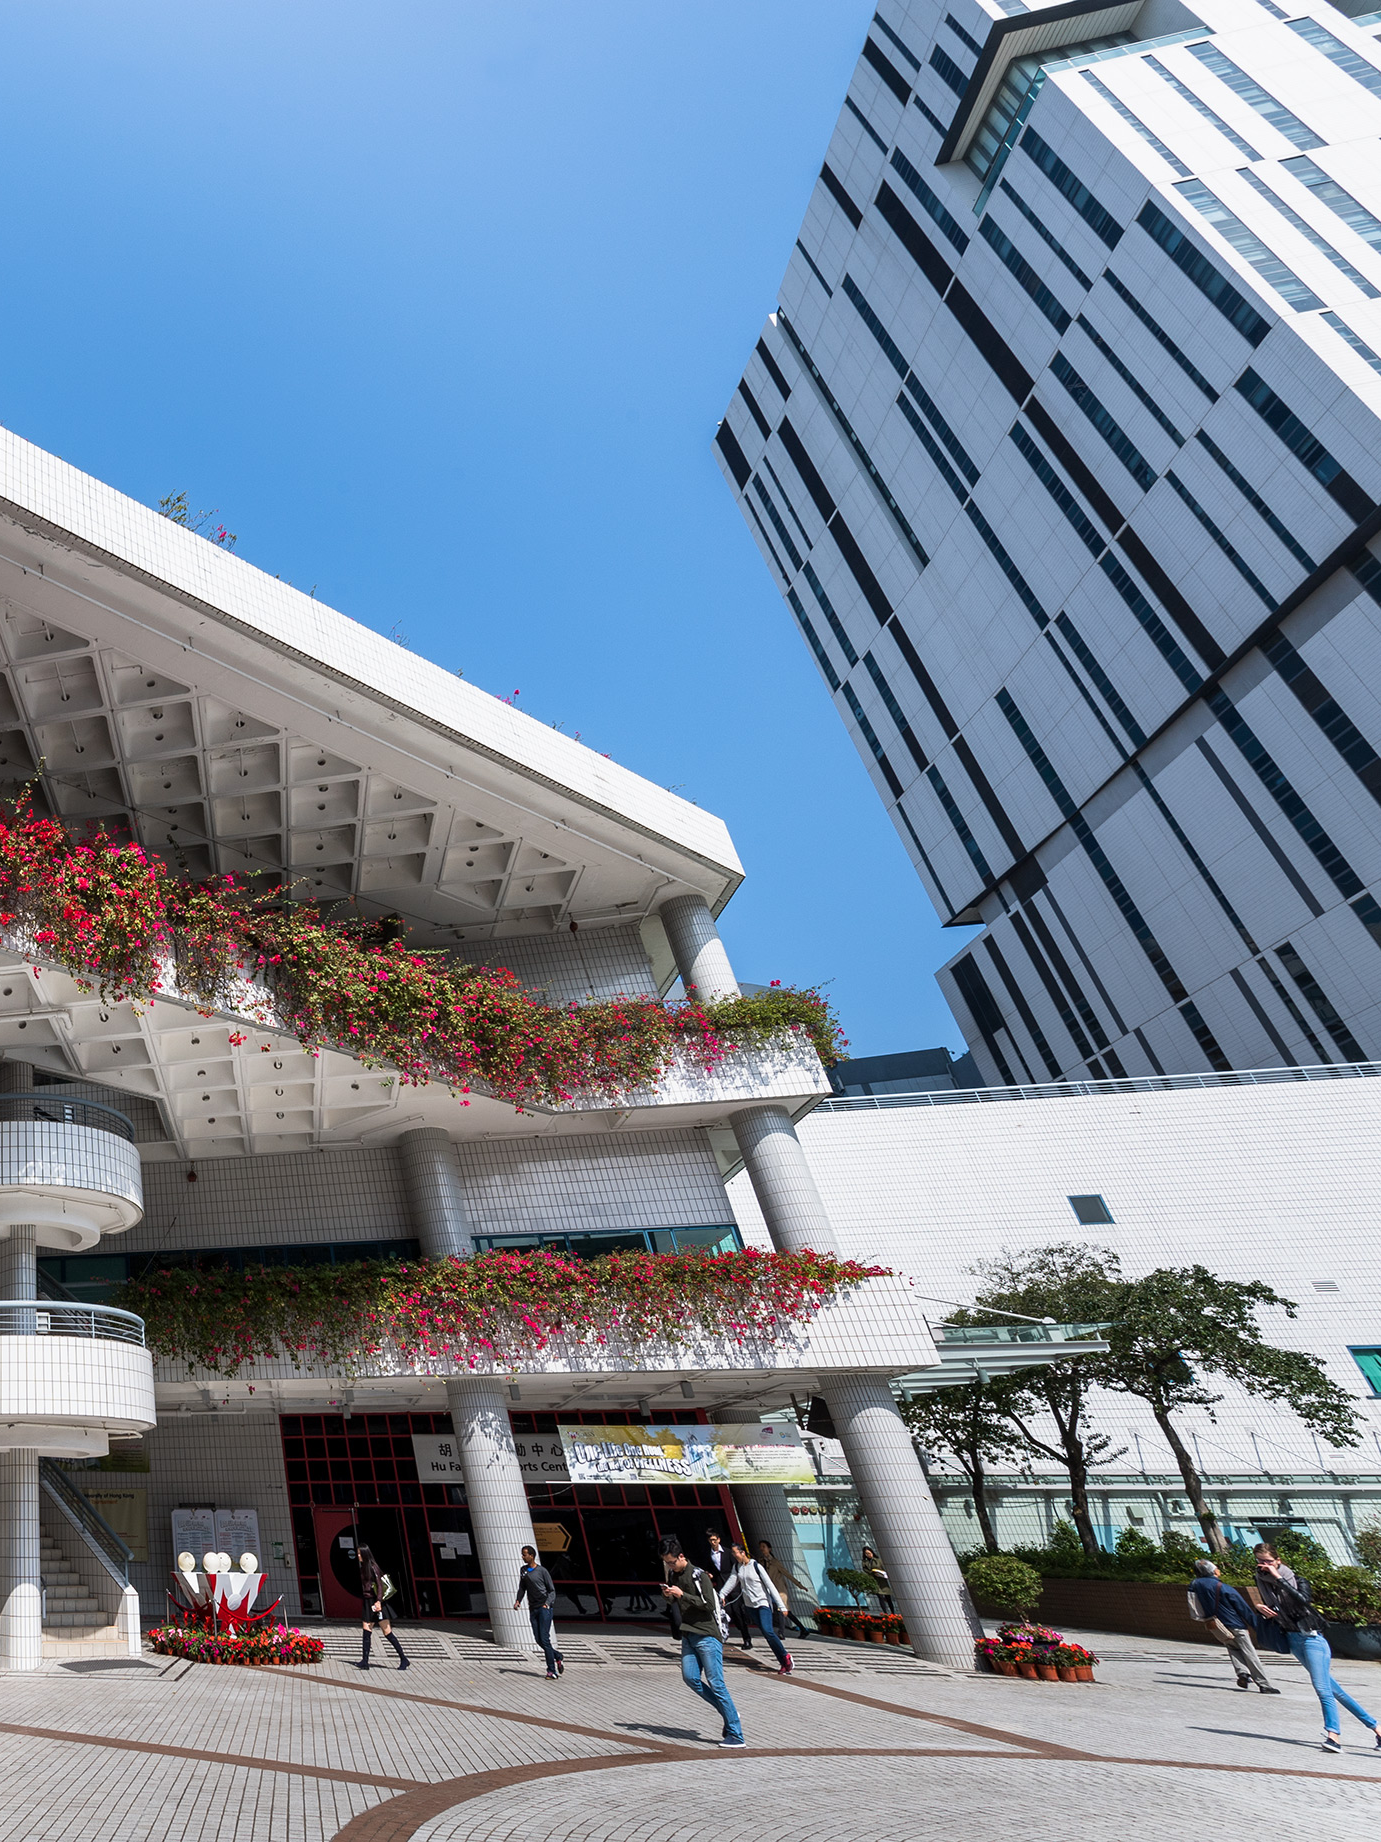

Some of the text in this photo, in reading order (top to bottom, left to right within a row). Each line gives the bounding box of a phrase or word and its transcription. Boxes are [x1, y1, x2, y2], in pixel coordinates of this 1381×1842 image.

[573, 1441, 602, 1464] One
[600, 1442, 623, 1458] Life
[623, 1443, 642, 1457] One
[431, 1462, 446, 1472] Hu
[633, 1458, 692, 1476] WELLNESS
